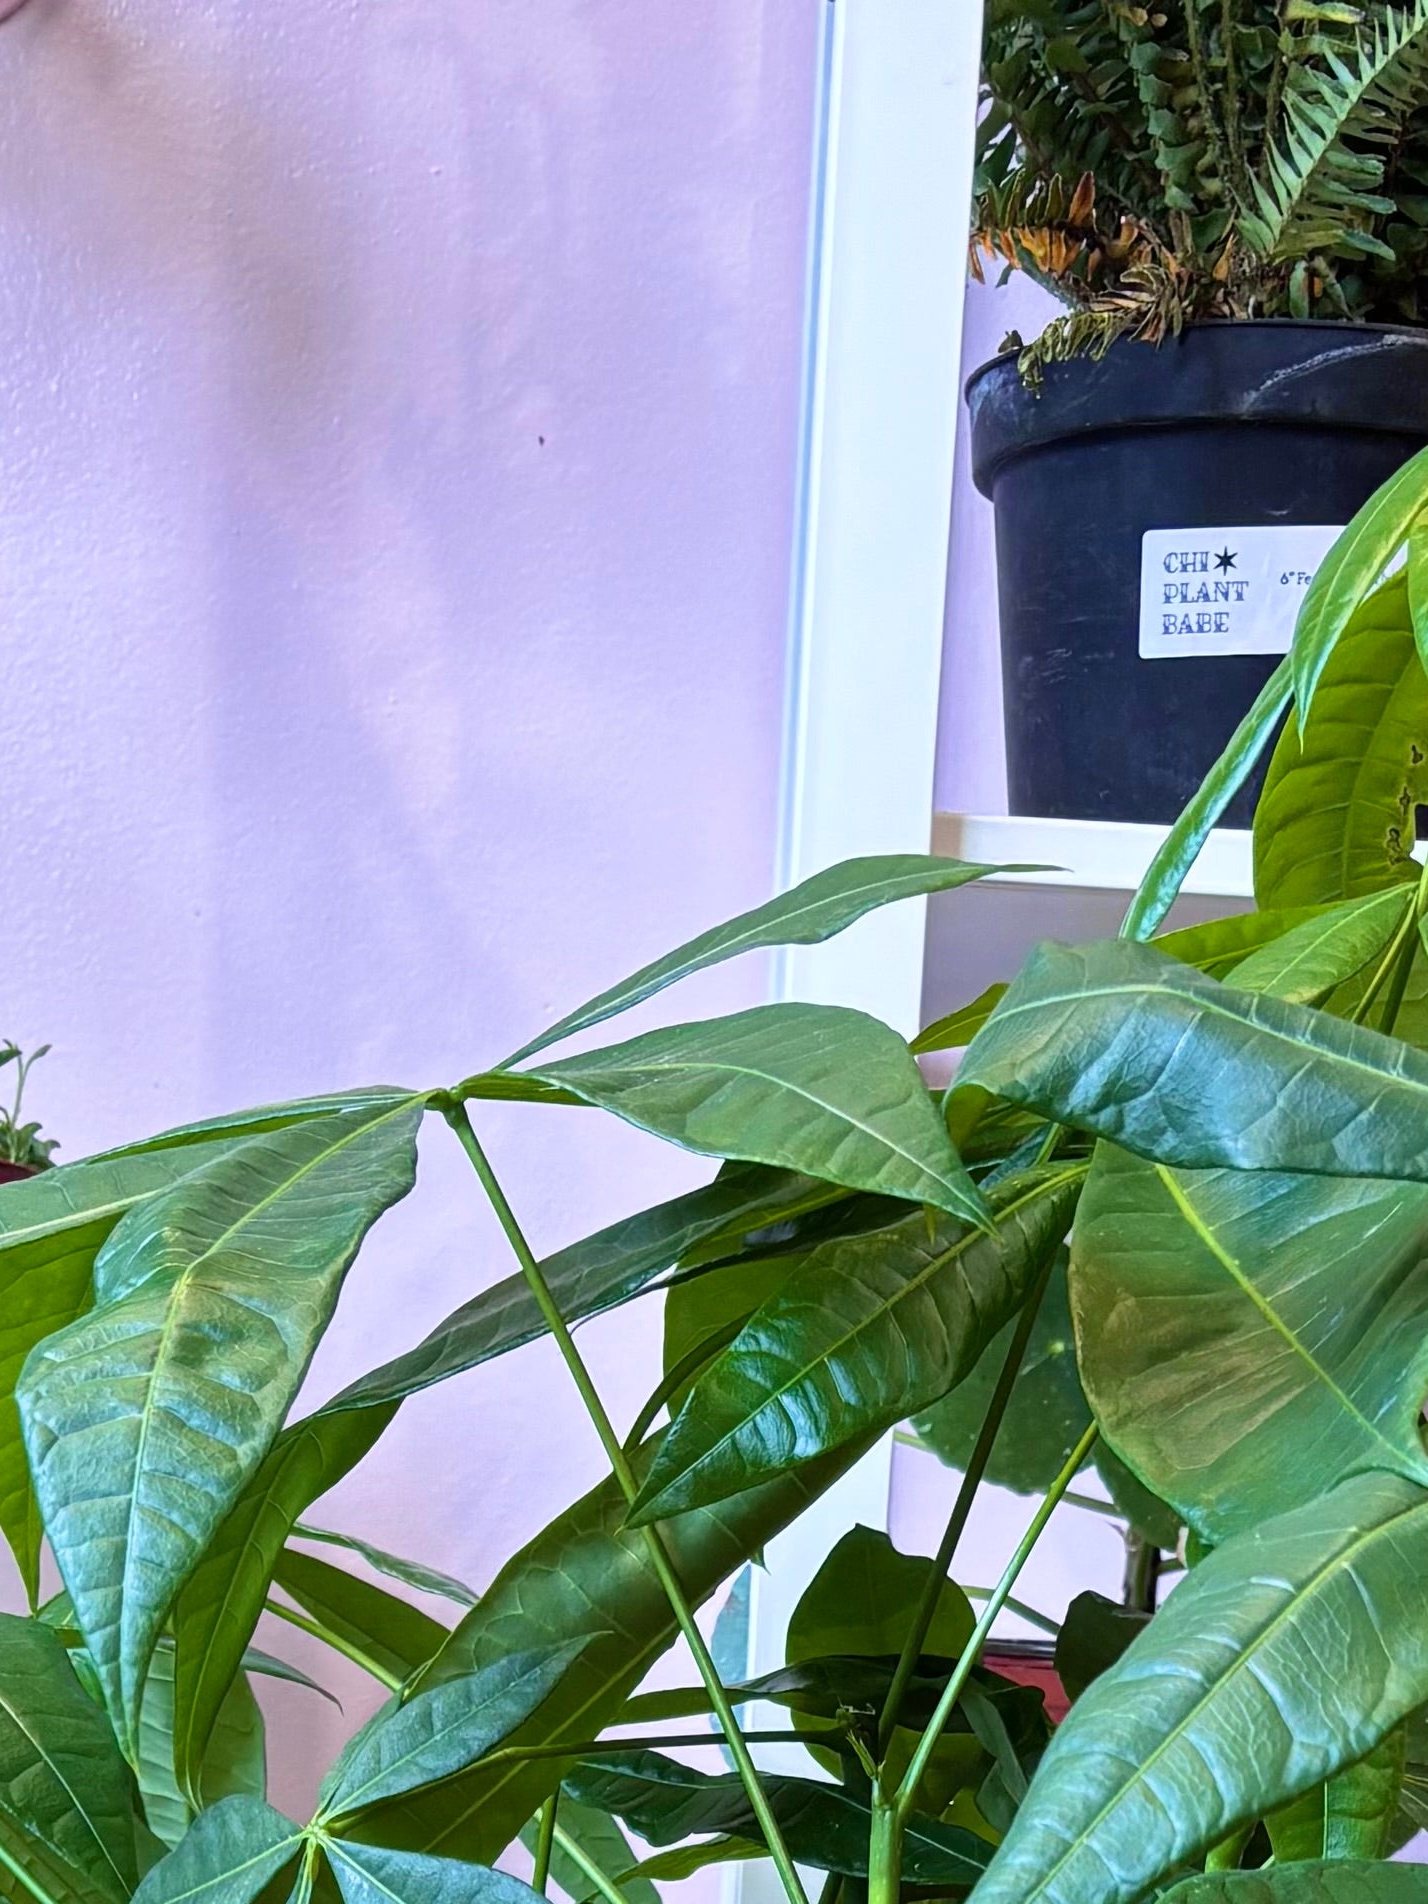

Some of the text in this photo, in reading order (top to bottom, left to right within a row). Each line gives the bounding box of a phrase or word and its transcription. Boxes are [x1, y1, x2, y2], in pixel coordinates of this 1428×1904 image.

[1163, 552, 1210, 574] CHI
[1163, 581, 1249, 604] PLANT
[1162, 612, 1230, 635] BABE
